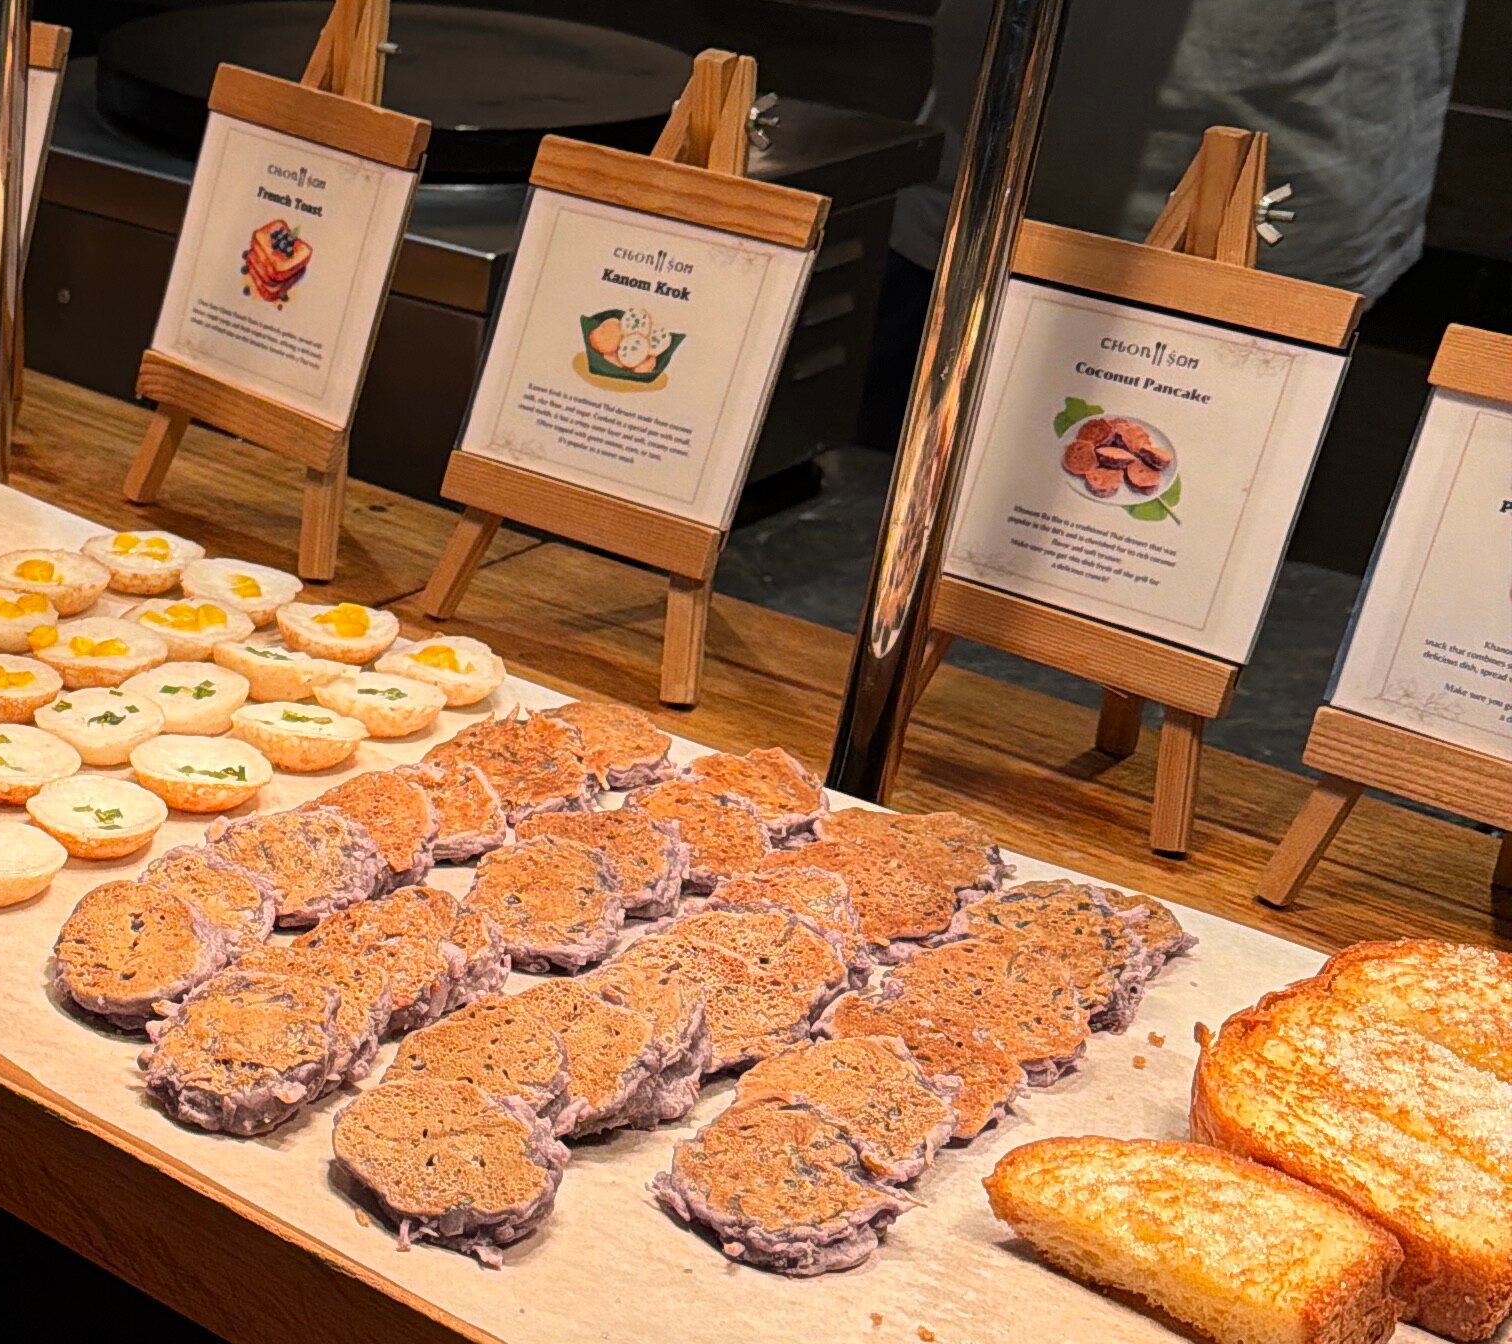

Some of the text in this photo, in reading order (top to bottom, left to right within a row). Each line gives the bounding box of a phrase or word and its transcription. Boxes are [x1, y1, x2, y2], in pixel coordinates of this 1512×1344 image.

[257, 186, 323, 217] French Toast
[601, 268, 691, 301] Kanom Krok
[1075, 361, 1211, 404] Coconut Pancake
[1423, 651, 1458, 666] delicious
[1449, 645, 1466, 655] that
[1445, 683, 1468, 696] Make
[1470, 692, 1486, 702] sure
[1487, 698, 1503, 706] you
